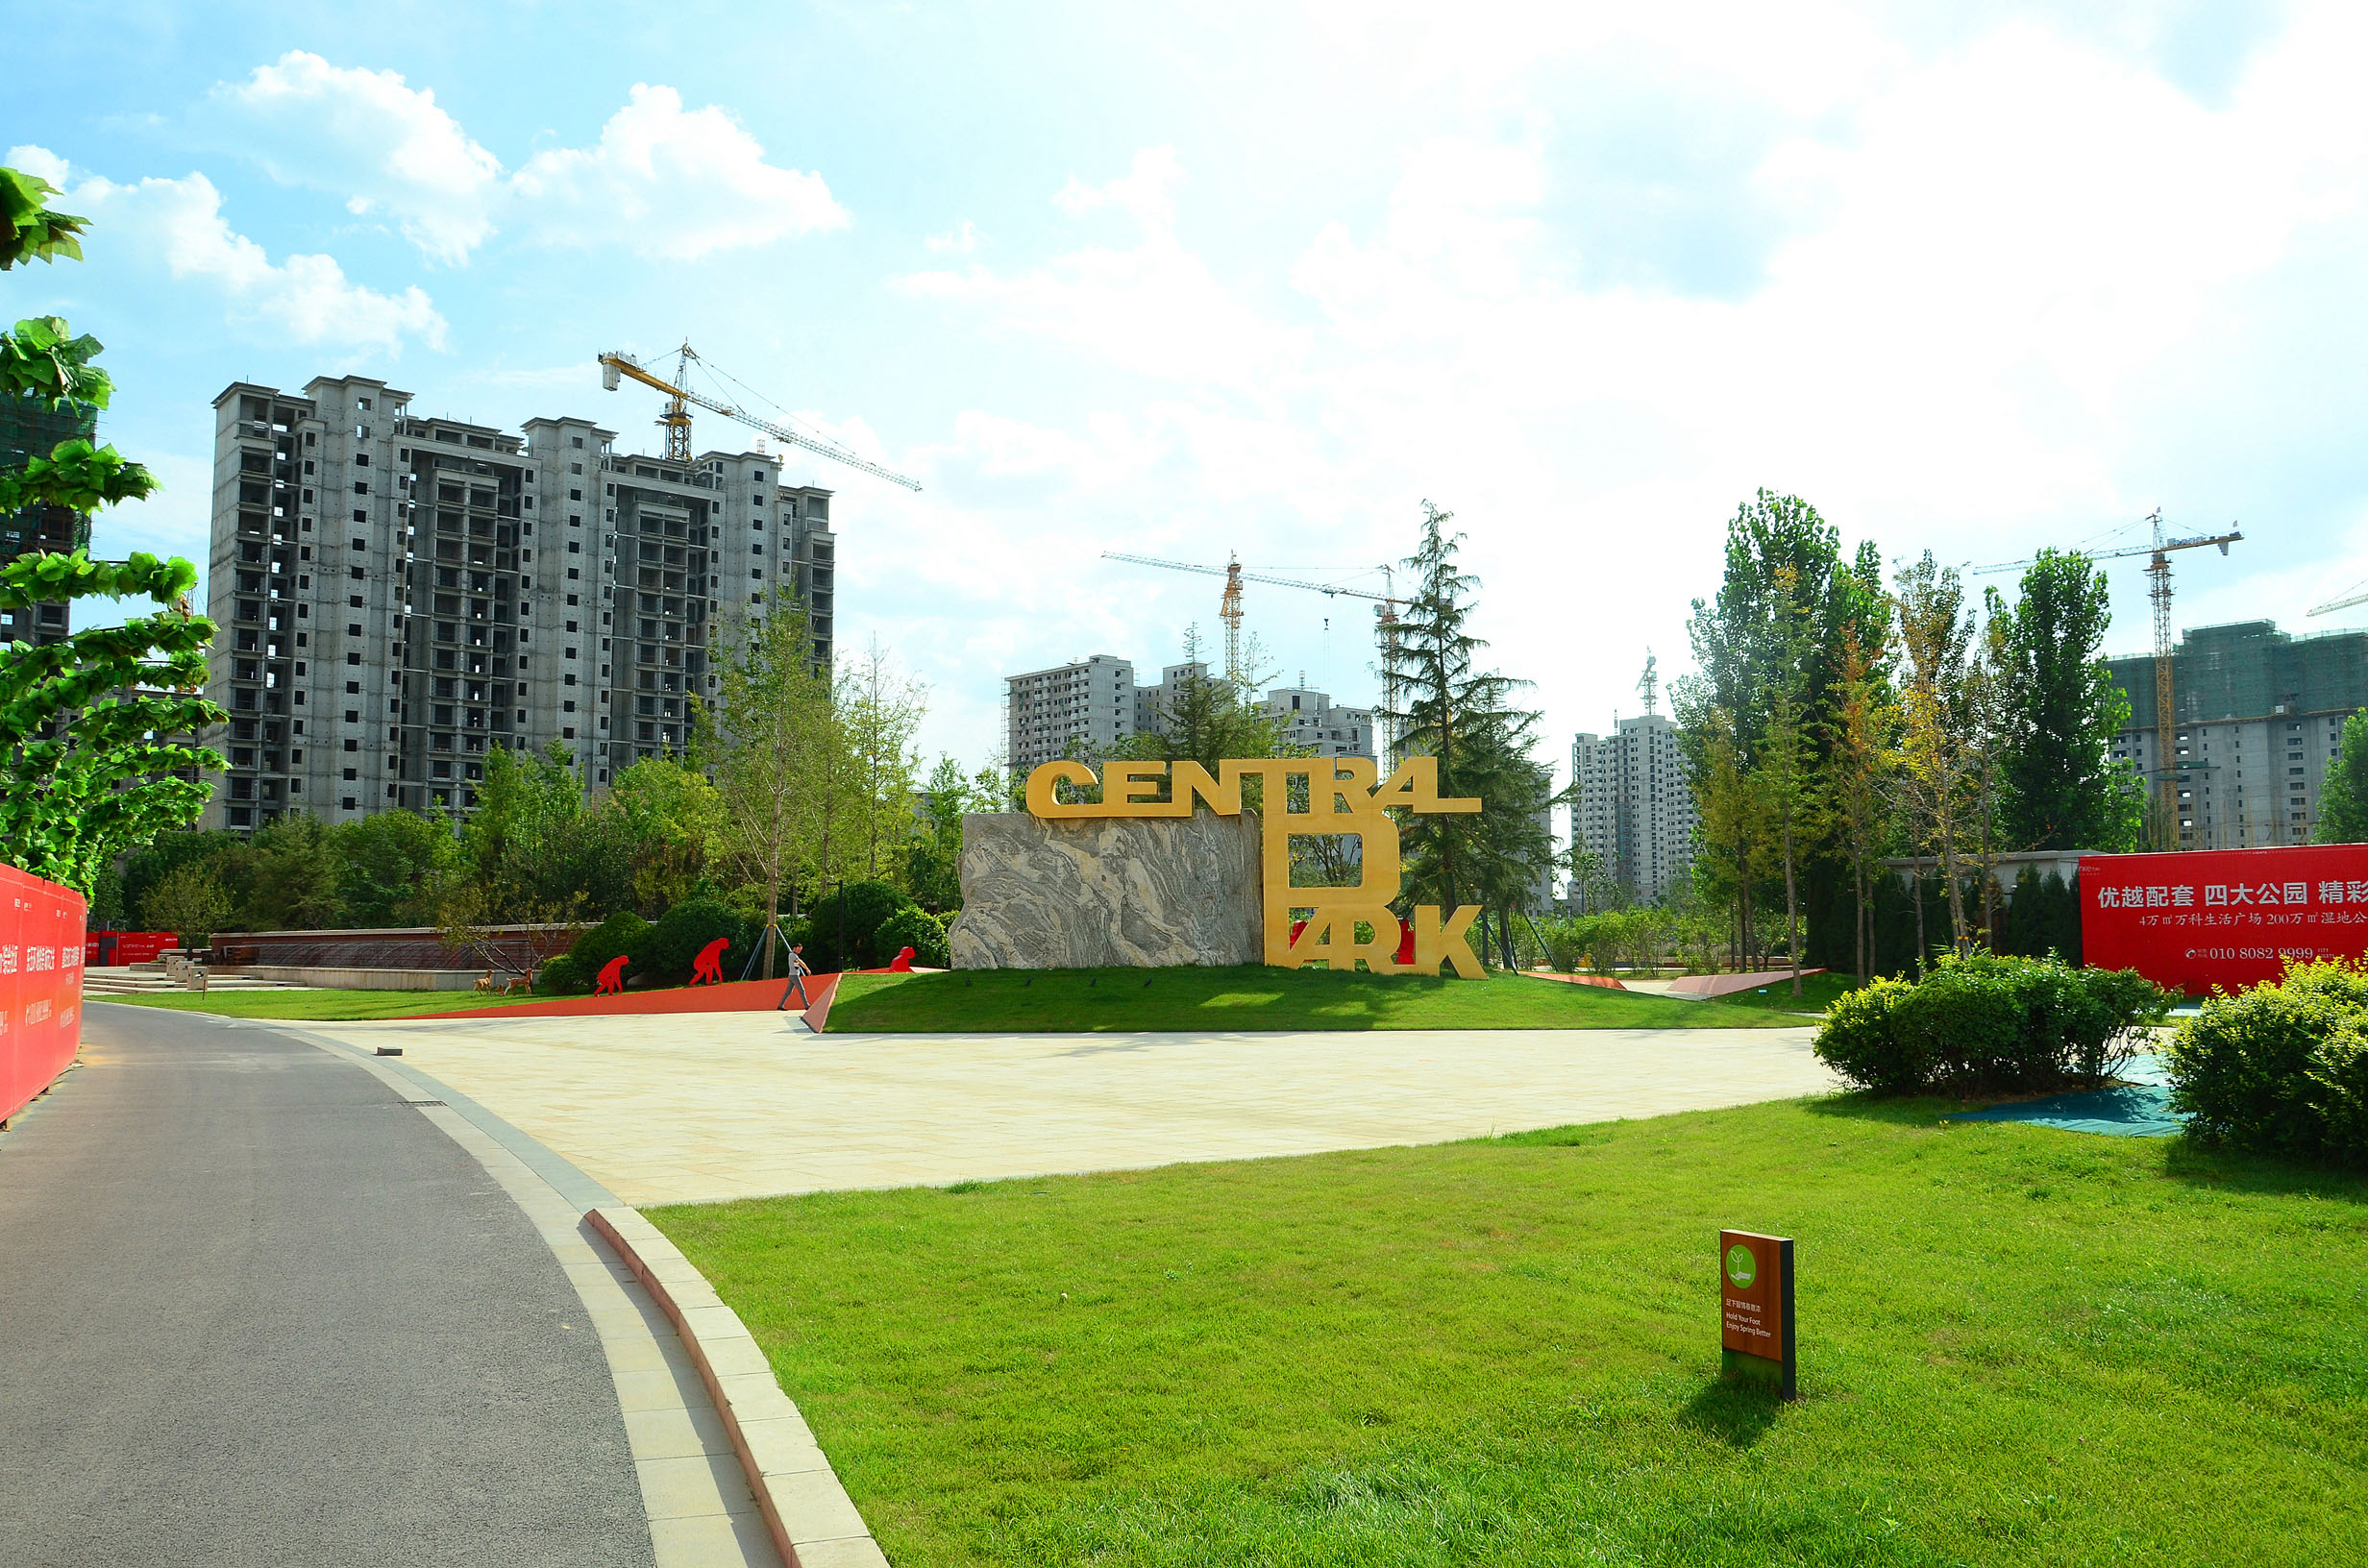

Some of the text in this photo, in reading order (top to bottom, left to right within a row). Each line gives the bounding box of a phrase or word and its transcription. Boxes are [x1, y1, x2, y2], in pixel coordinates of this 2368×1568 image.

[1025, 756, 1483, 819] CENTRAL
[1263, 812, 1489, 980] PARK
[2098, 880, 2368, 908] 优越配套 四大公园 精彩
[2210, 947, 2235, 960] 010
[2239, 947, 2274, 960] 8082
[2278, 947, 2314, 960] 9999
[1726, 1311, 1761, 1326] Hold Your Foot
[1726, 1321, 1771, 1338] Enjoy Spring Better
